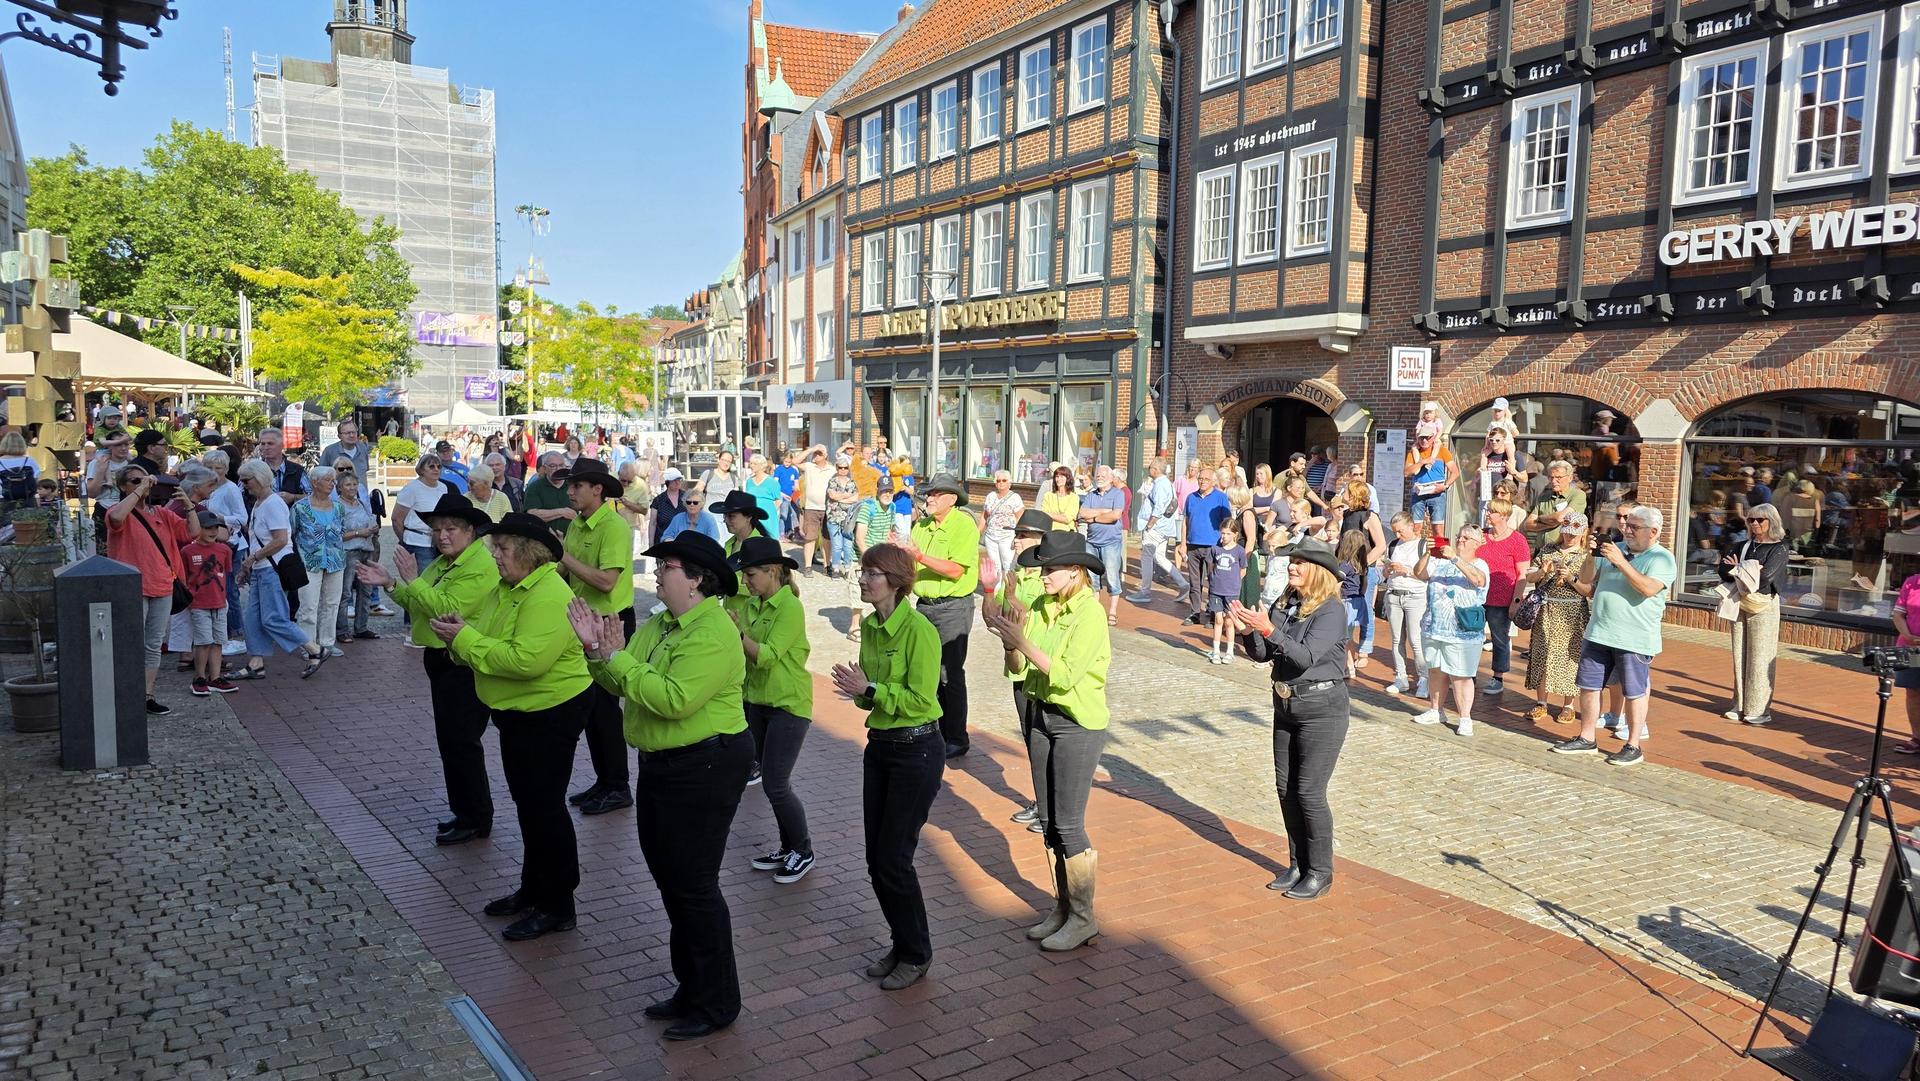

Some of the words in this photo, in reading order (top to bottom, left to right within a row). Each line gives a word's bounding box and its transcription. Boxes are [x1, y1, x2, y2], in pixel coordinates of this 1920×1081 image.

[1214, 141, 1229, 157] ist
[1232, 133, 1257, 152] 1945
[1658, 215, 1801, 266] GERRY
[1808, 202, 1920, 250] WEB
[1695, 295, 1727, 310] der
[1792, 284, 1843, 303] doch
[879, 309, 927, 337] ALTE
[939, 291, 1066, 331] APOTHEKE
[1397, 370, 1425, 380] PUNKT
[1401, 357, 1422, 369] STIL
[1219, 380, 1333, 408] BURGMANNSHOF
